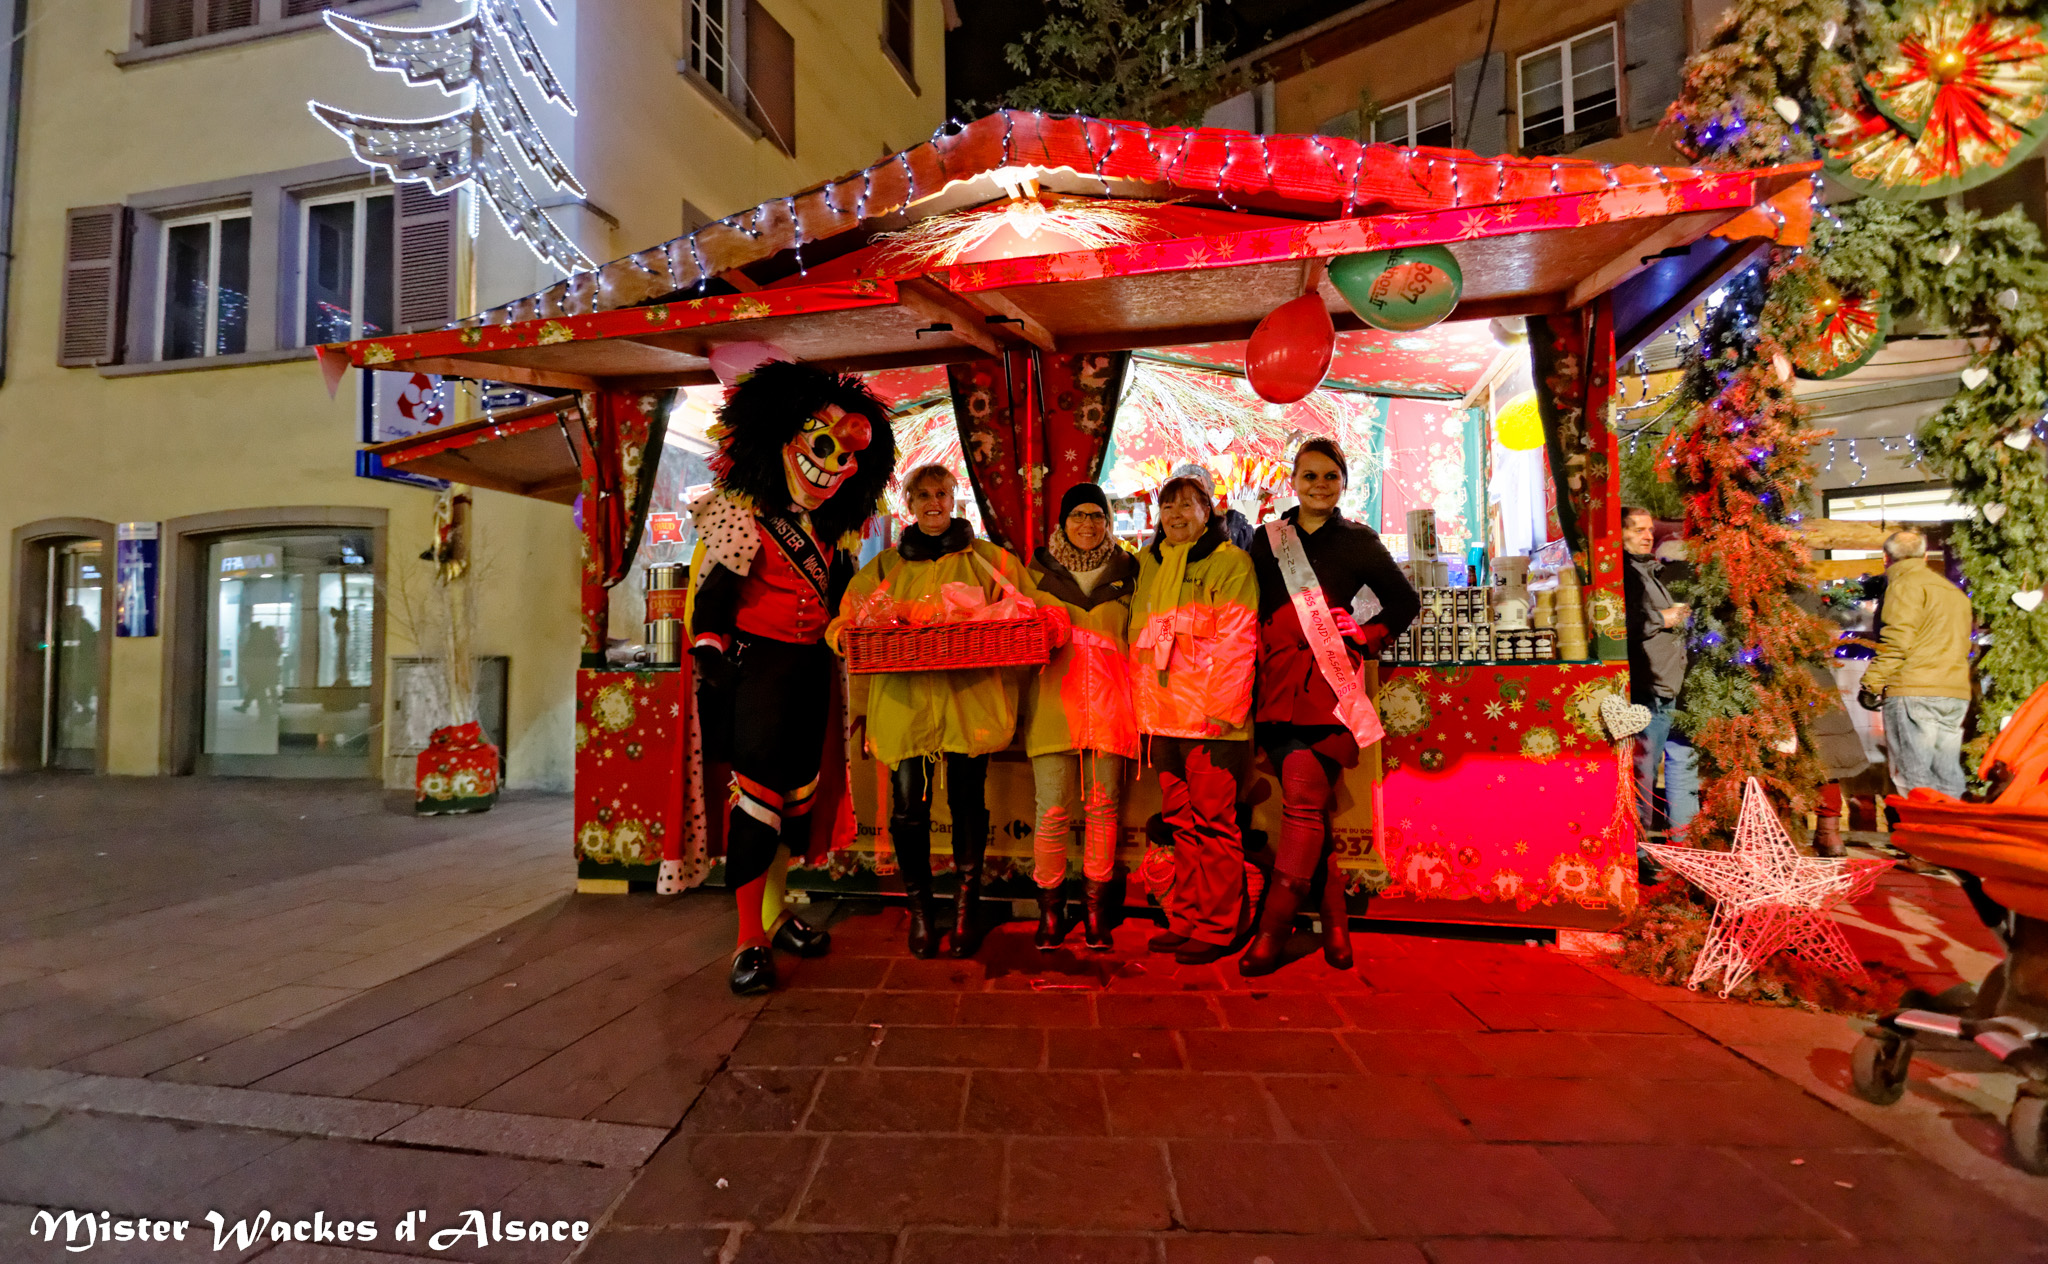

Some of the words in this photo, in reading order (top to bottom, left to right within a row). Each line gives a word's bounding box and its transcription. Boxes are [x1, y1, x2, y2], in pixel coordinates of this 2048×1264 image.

[1370, 249, 1403, 310] elethon.fr
[1400, 261, 1432, 304] 3637
[770, 516, 805, 552] MISTER
[1300, 586, 1315, 607] MISS
[1310, 610, 1331, 645] RONDE
[1326, 650, 1347, 684] ALSACE
[1337, 682, 1357, 698] 2013
[1333, 835, 1374, 856] 637
